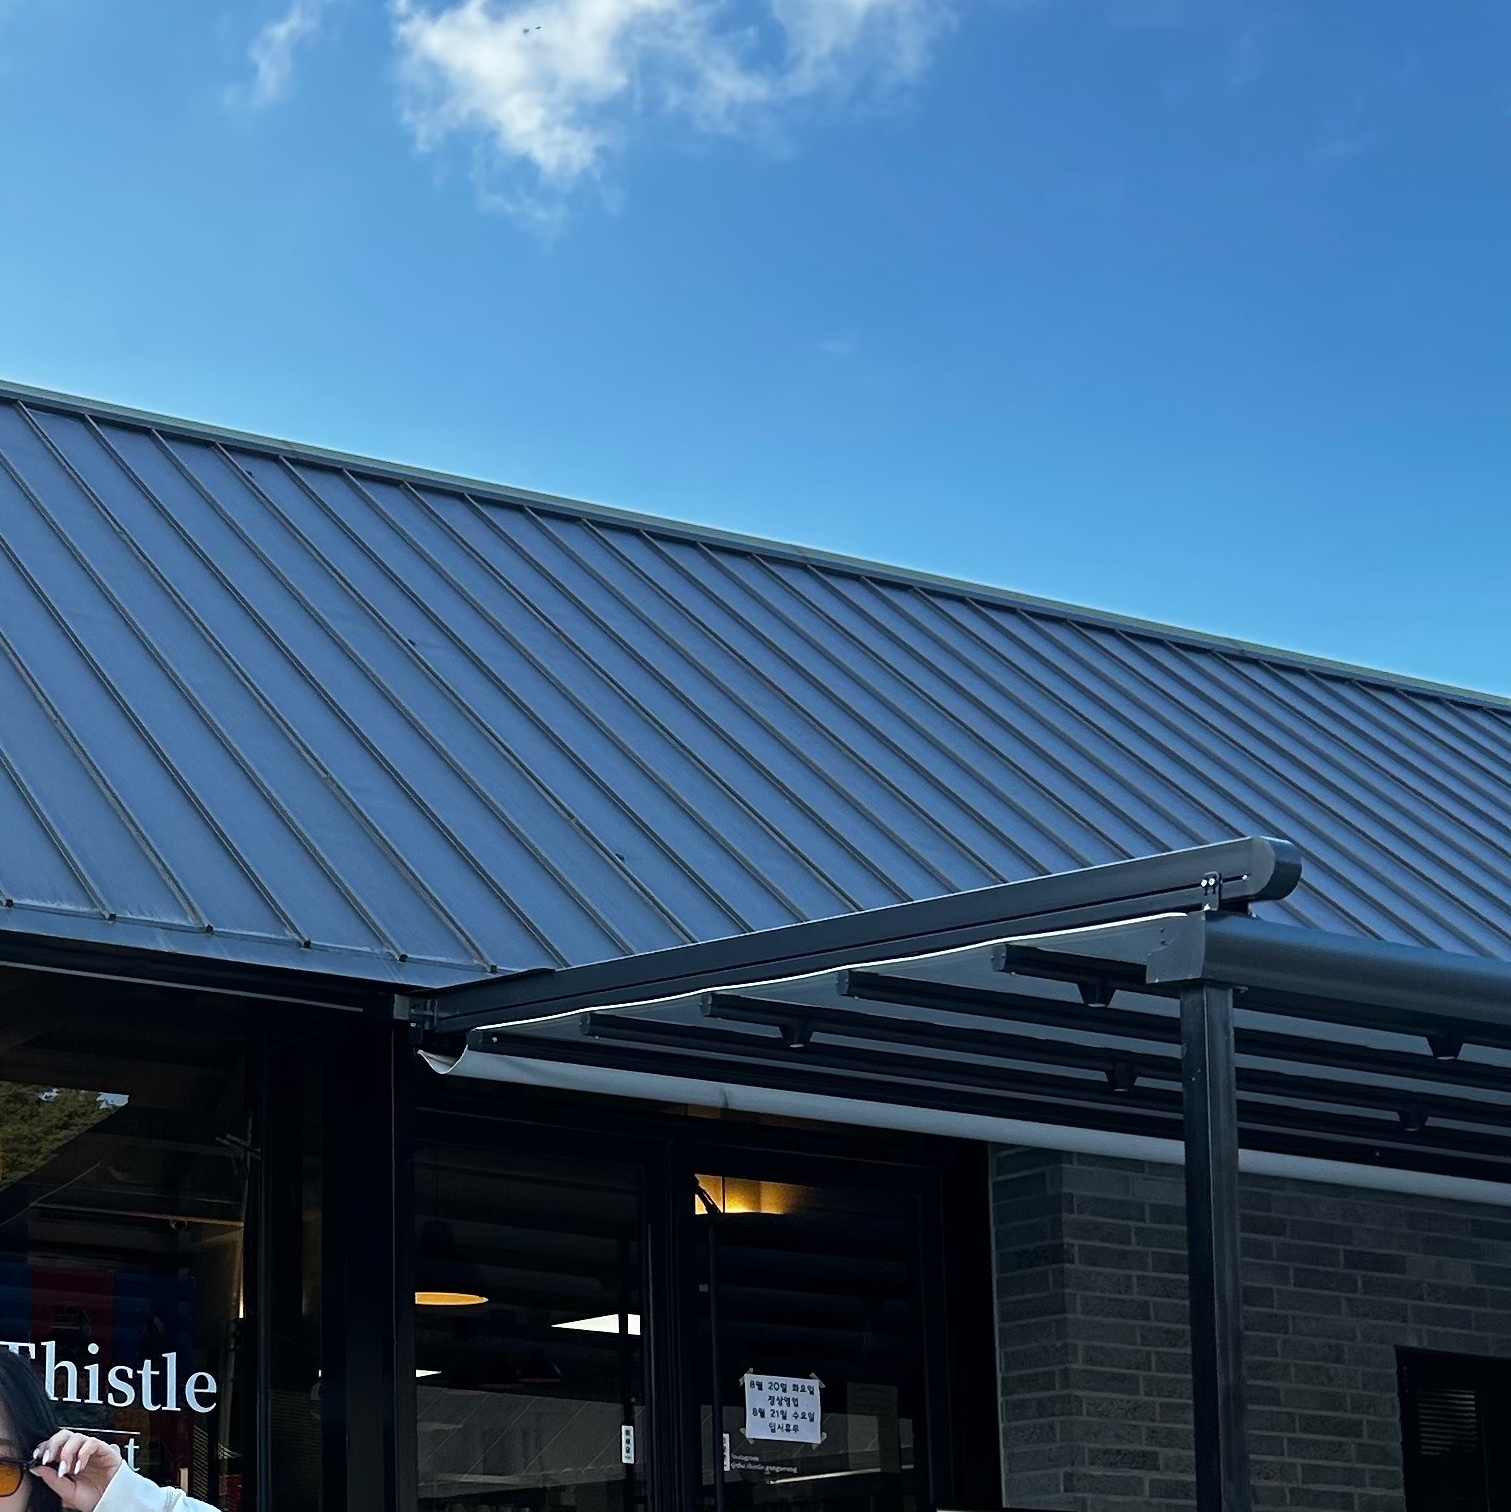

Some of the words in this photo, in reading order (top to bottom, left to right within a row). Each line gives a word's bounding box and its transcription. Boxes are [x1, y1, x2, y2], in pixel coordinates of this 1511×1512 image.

[749, 1380, 763, 1391] 8월
[768, 1381, 787, 1393] 20일
[768, 1395, 799, 1408] 정상영업
[752, 1407, 765, 1418] 8월
[770, 1408, 787, 1420] 21일
[792, 1411, 815, 1422] 수요일
